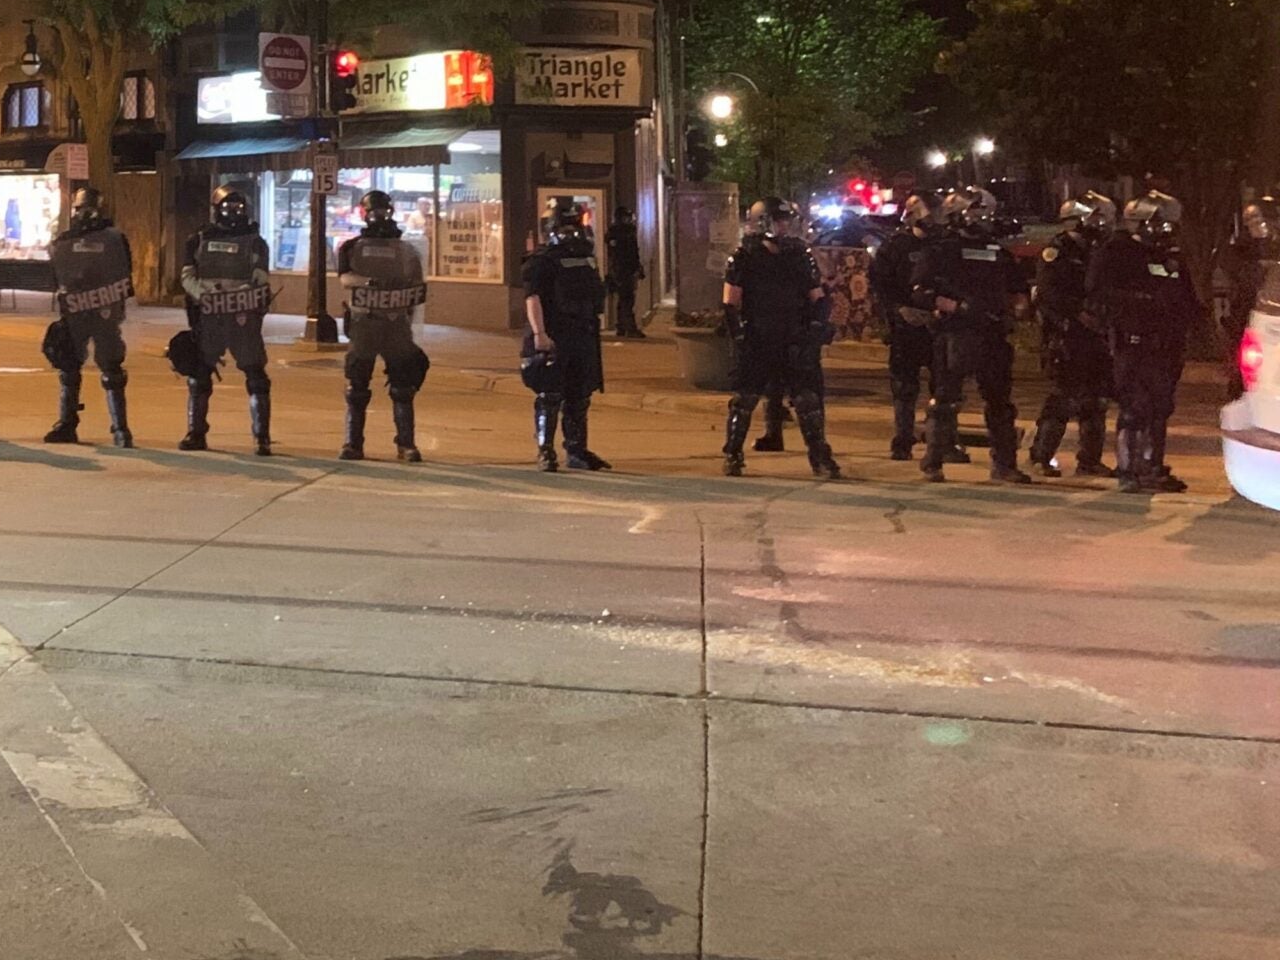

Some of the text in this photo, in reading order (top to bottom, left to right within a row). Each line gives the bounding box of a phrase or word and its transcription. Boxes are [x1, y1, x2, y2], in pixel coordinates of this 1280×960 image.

[283, 47, 300, 57] NOT
[270, 69, 300, 81] ENTER
[526, 53, 627, 81] Triangle
[534, 76, 625, 99] Market
[317, 174, 334, 192] 15
[66, 278, 130, 313] SHERIFF
[202, 286, 269, 315] SHERIFF
[355, 285, 424, 309] SHERIFF
